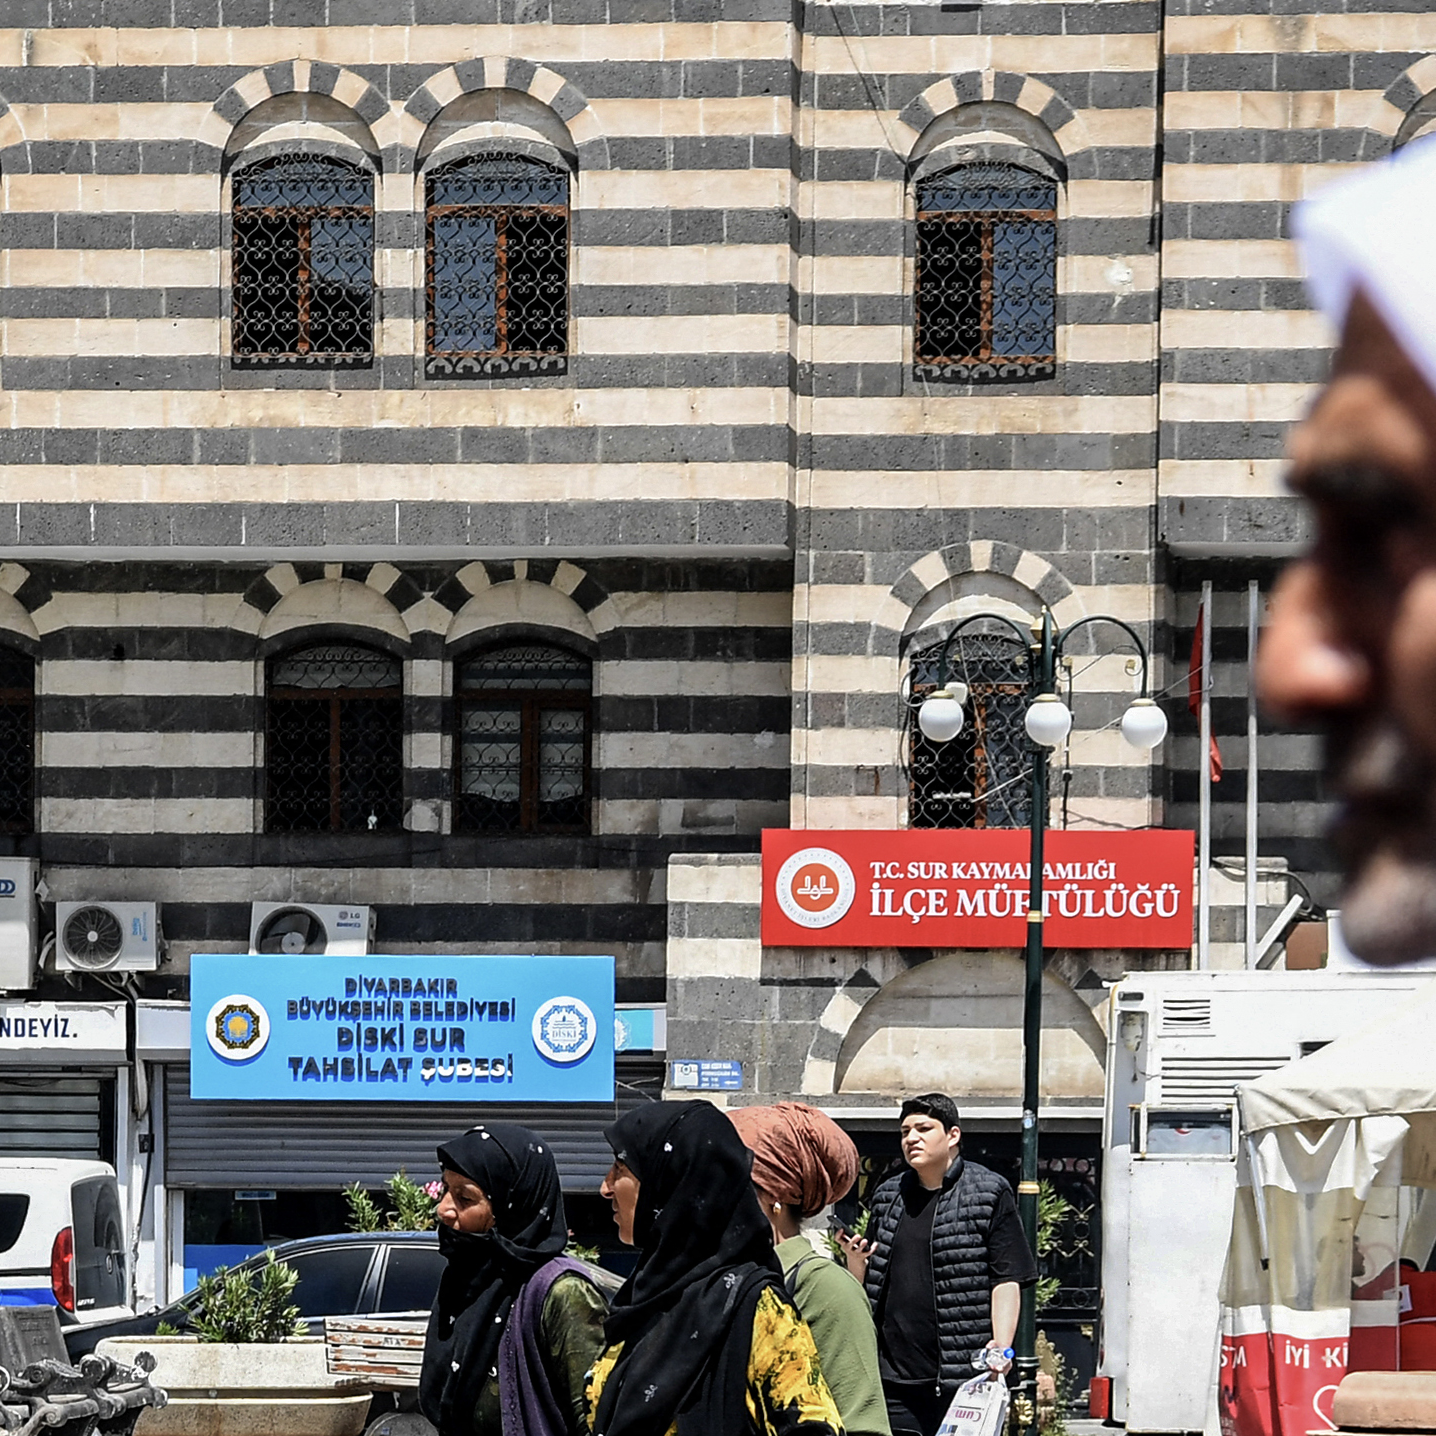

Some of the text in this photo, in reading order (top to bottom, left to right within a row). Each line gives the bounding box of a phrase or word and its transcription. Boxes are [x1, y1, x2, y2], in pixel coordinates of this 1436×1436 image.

[870, 859, 1116, 880] T.C. SUR KAYMAAMLIĞI
[870, 882, 948, 924] İLÇE
[953, 882, 1181, 918] MÜFTÜLÜĞÜ
[345, 974, 458, 998] DİYARBAKIR
[287, 996, 516, 1023] BÜYÜKŞEHİR BELEDİYESİ
[337, 1022, 466, 1052] DİSKİ SUR
[288, 1053, 513, 1087] TAHSİLAT ŞUBESİ
[1285, 1339, 1310, 1369] İYİ
